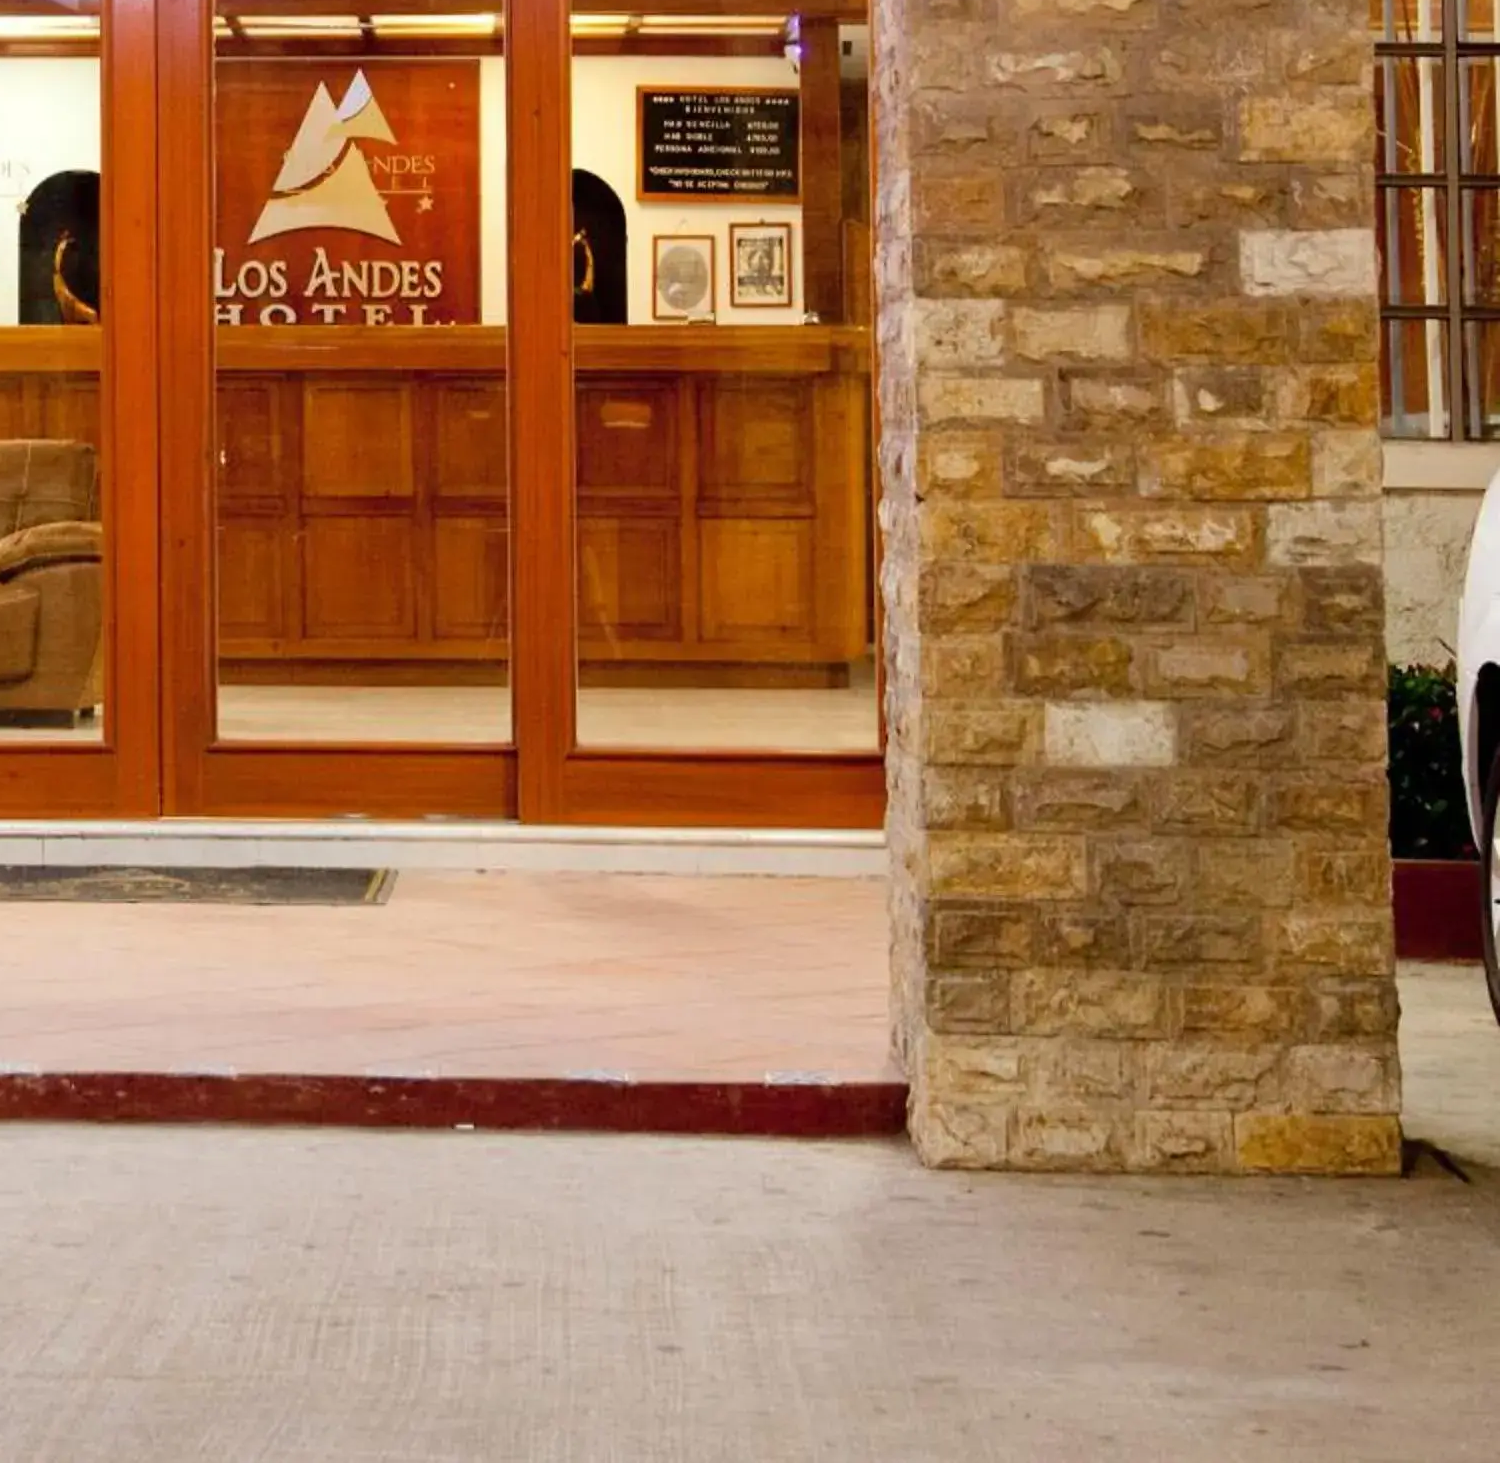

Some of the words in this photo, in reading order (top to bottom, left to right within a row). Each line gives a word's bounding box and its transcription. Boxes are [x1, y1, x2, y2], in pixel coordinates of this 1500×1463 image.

[367, 155, 436, 174] NDES
[213, 247, 288, 298] LOS
[303, 246, 442, 298] ANDES
[214, 303, 438, 326] HOTEL
